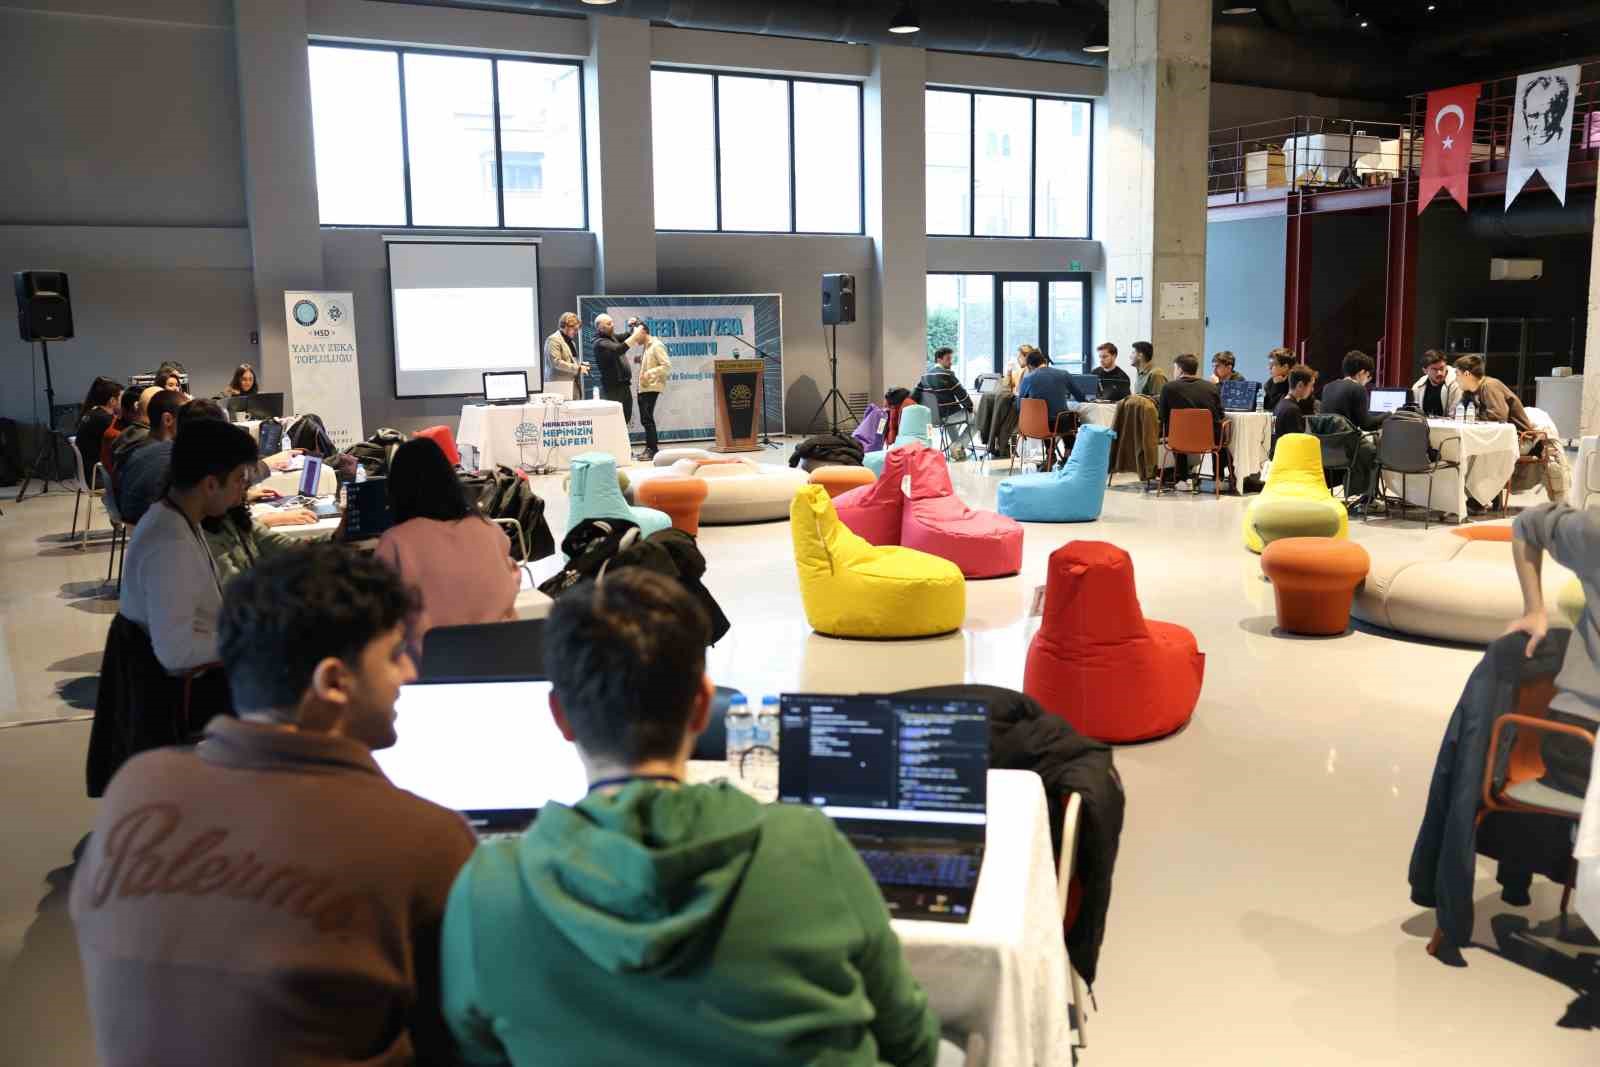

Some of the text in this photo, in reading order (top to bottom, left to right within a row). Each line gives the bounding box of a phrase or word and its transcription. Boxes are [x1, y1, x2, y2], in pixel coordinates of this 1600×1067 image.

[675, 318, 712, 337] YAPAY
[291, 343, 354, 353] YAPAY ZEKA
[543, 427, 593, 437] HEPİMİZİN
